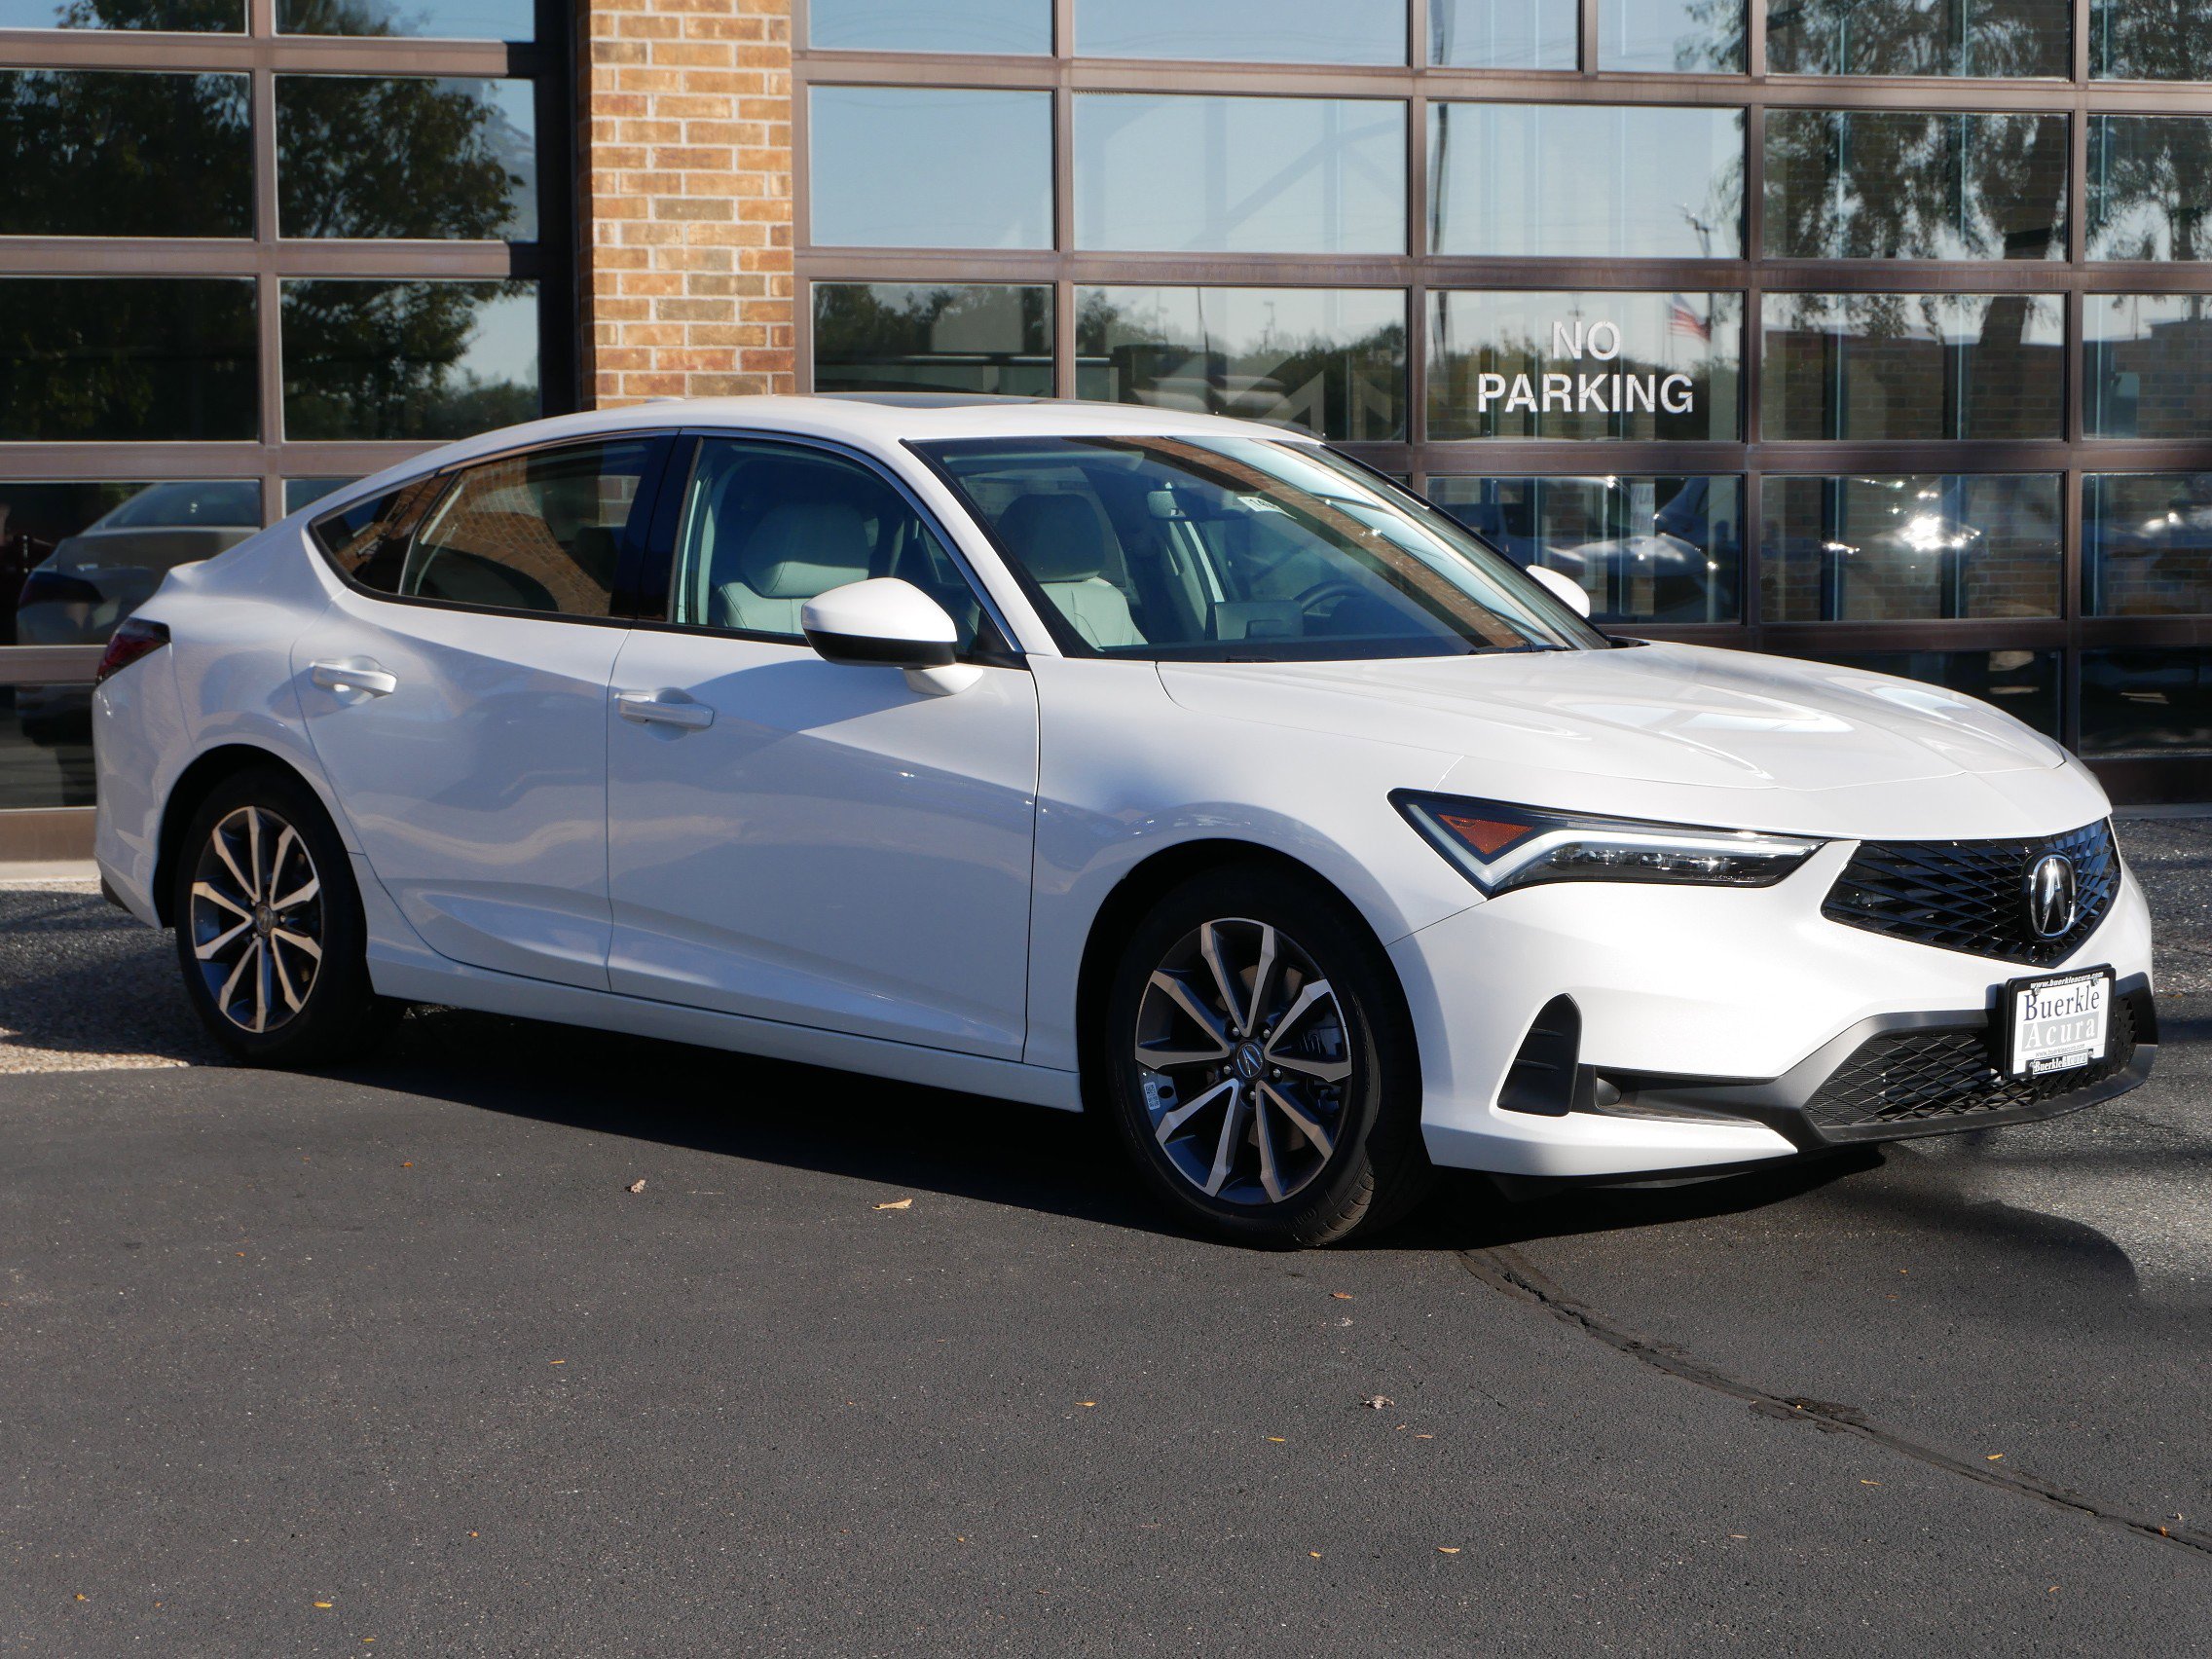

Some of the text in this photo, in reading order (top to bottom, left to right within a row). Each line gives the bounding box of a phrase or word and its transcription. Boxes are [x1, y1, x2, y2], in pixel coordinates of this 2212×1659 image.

[1552, 320, 1621, 361] NO
[1478, 373, 1694, 414] PARKING
[2030, 972, 2104, 989] www.buerkleacura.com
[2023, 985, 2100, 1021] Buerkle
[2025, 1018, 2095, 1049] Acura
